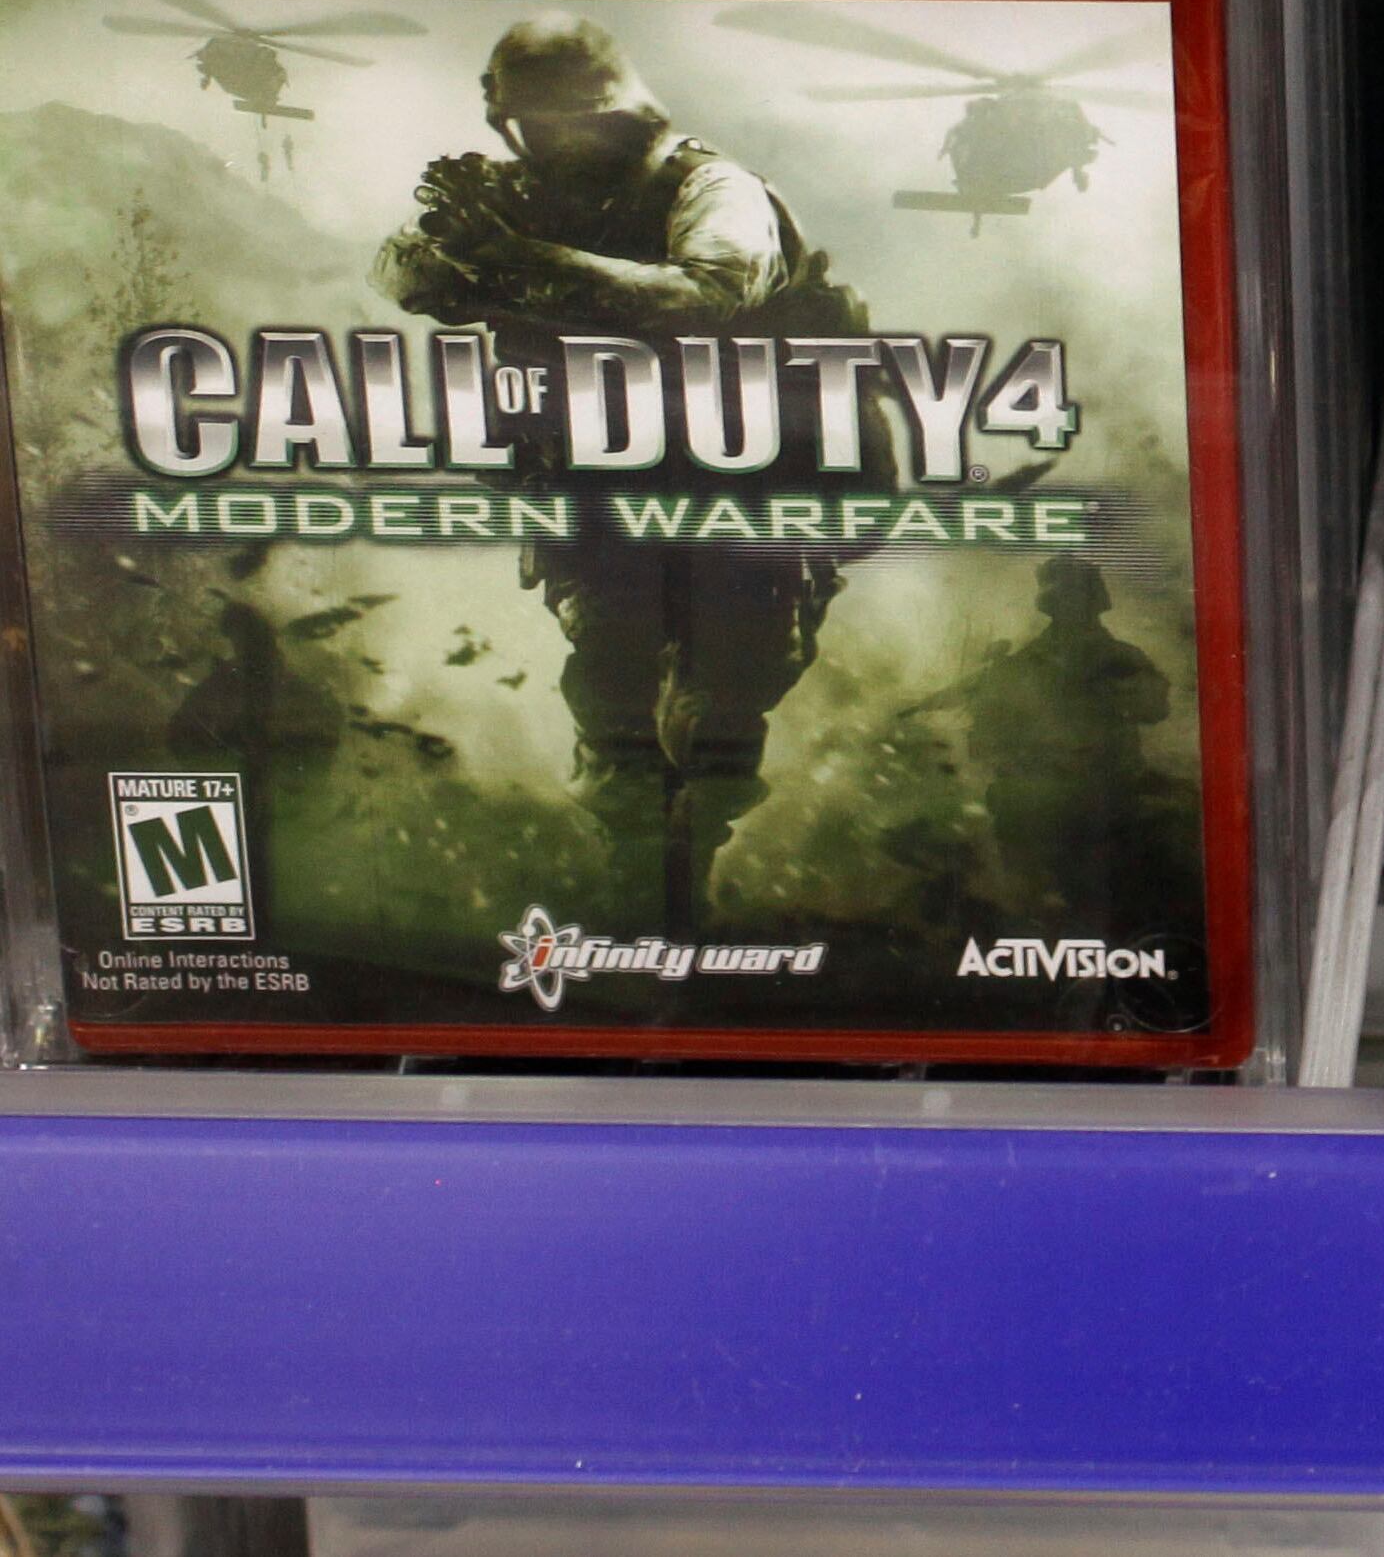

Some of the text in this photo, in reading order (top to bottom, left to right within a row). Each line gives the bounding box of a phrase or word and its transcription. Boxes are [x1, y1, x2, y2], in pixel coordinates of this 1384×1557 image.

[129, 328, 516, 477] CALL
[494, 366, 549, 416] OF
[136, 491, 1090, 544] MODERN WARFARE
[117, 779, 235, 797] MATURE 17+
[128, 805, 238, 897] M
[131, 917, 247, 933] ESRB
[98, 951, 289, 969] Online Interactions
[699, 943, 826, 974] ward
[83, 973, 310, 998] Not Rated by the ESRB
